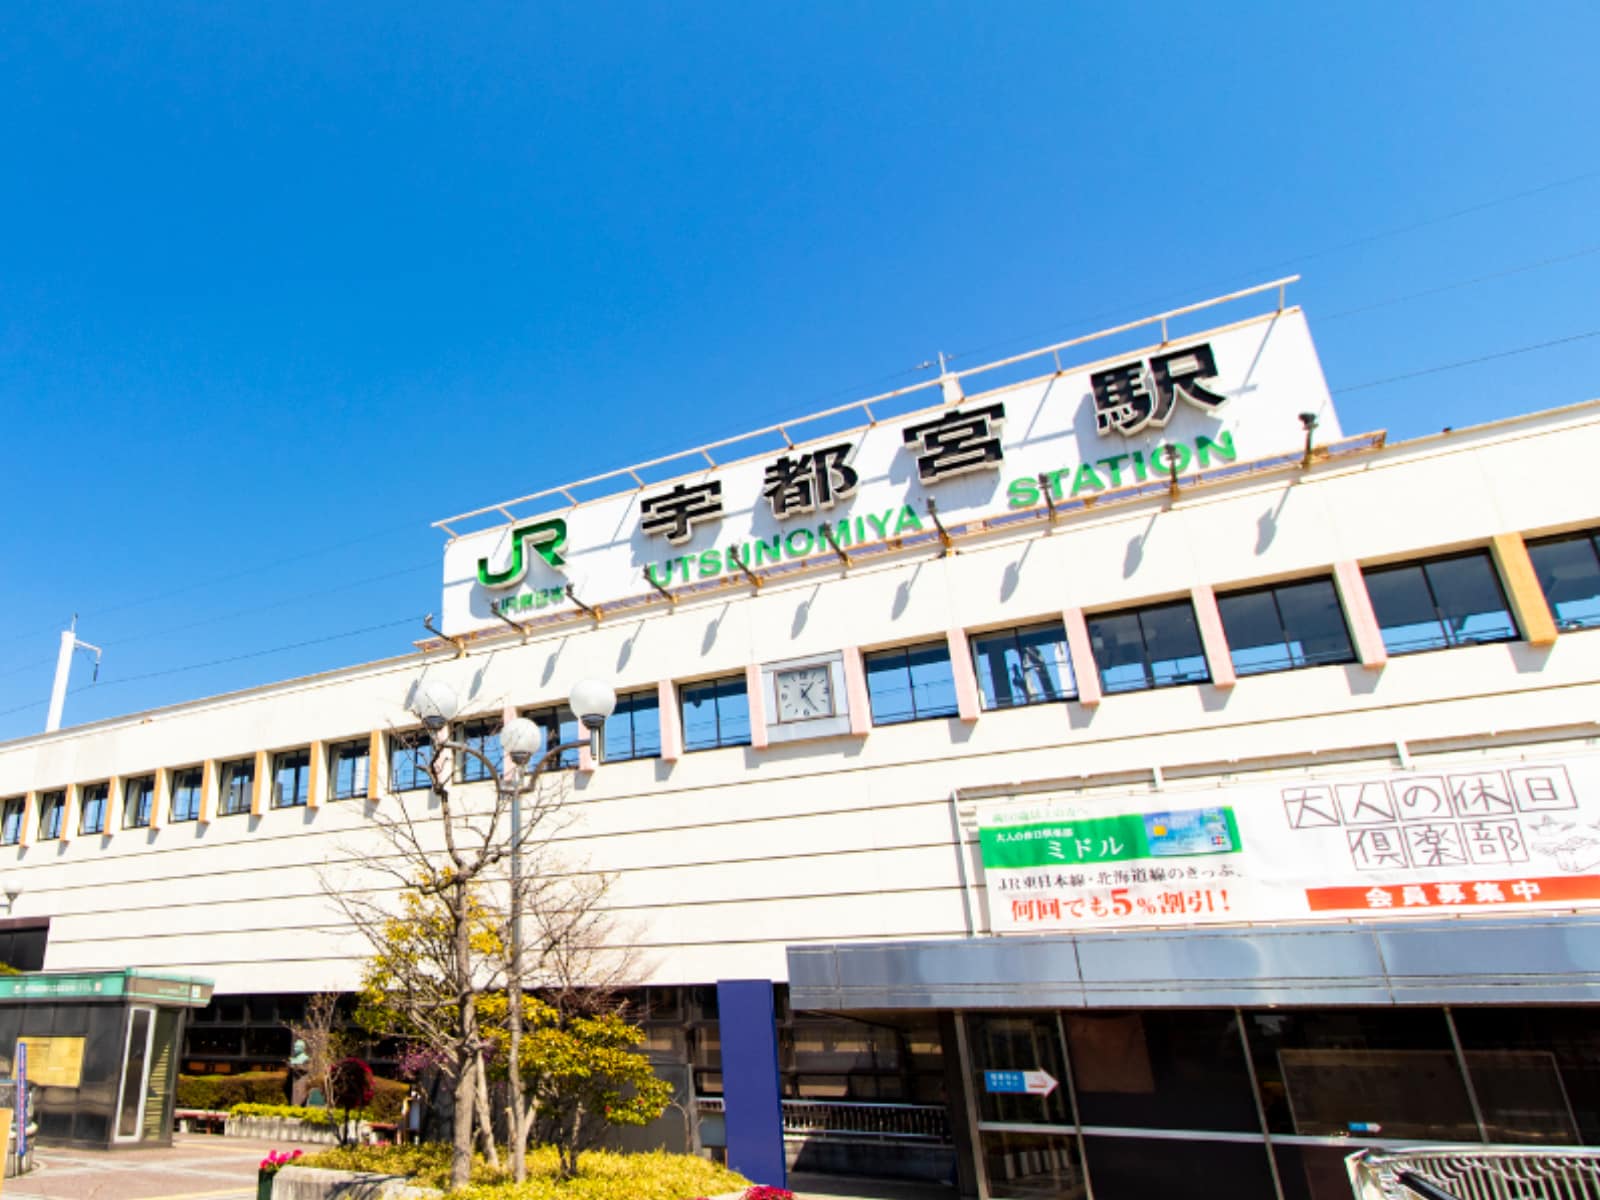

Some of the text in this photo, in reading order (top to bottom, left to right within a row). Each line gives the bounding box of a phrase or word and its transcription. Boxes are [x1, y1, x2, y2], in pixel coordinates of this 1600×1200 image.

[477, 342, 1228, 588] JR 宇都宮駅
[648, 431, 1237, 588] UTSUNOMIYA STATION
[1284, 775, 1559, 828] 大人の休日
[1048, 836, 1125, 859] ミドル
[1352, 822, 1520, 866] 倶楽部
[1364, 879, 1542, 909] 会員募集中
